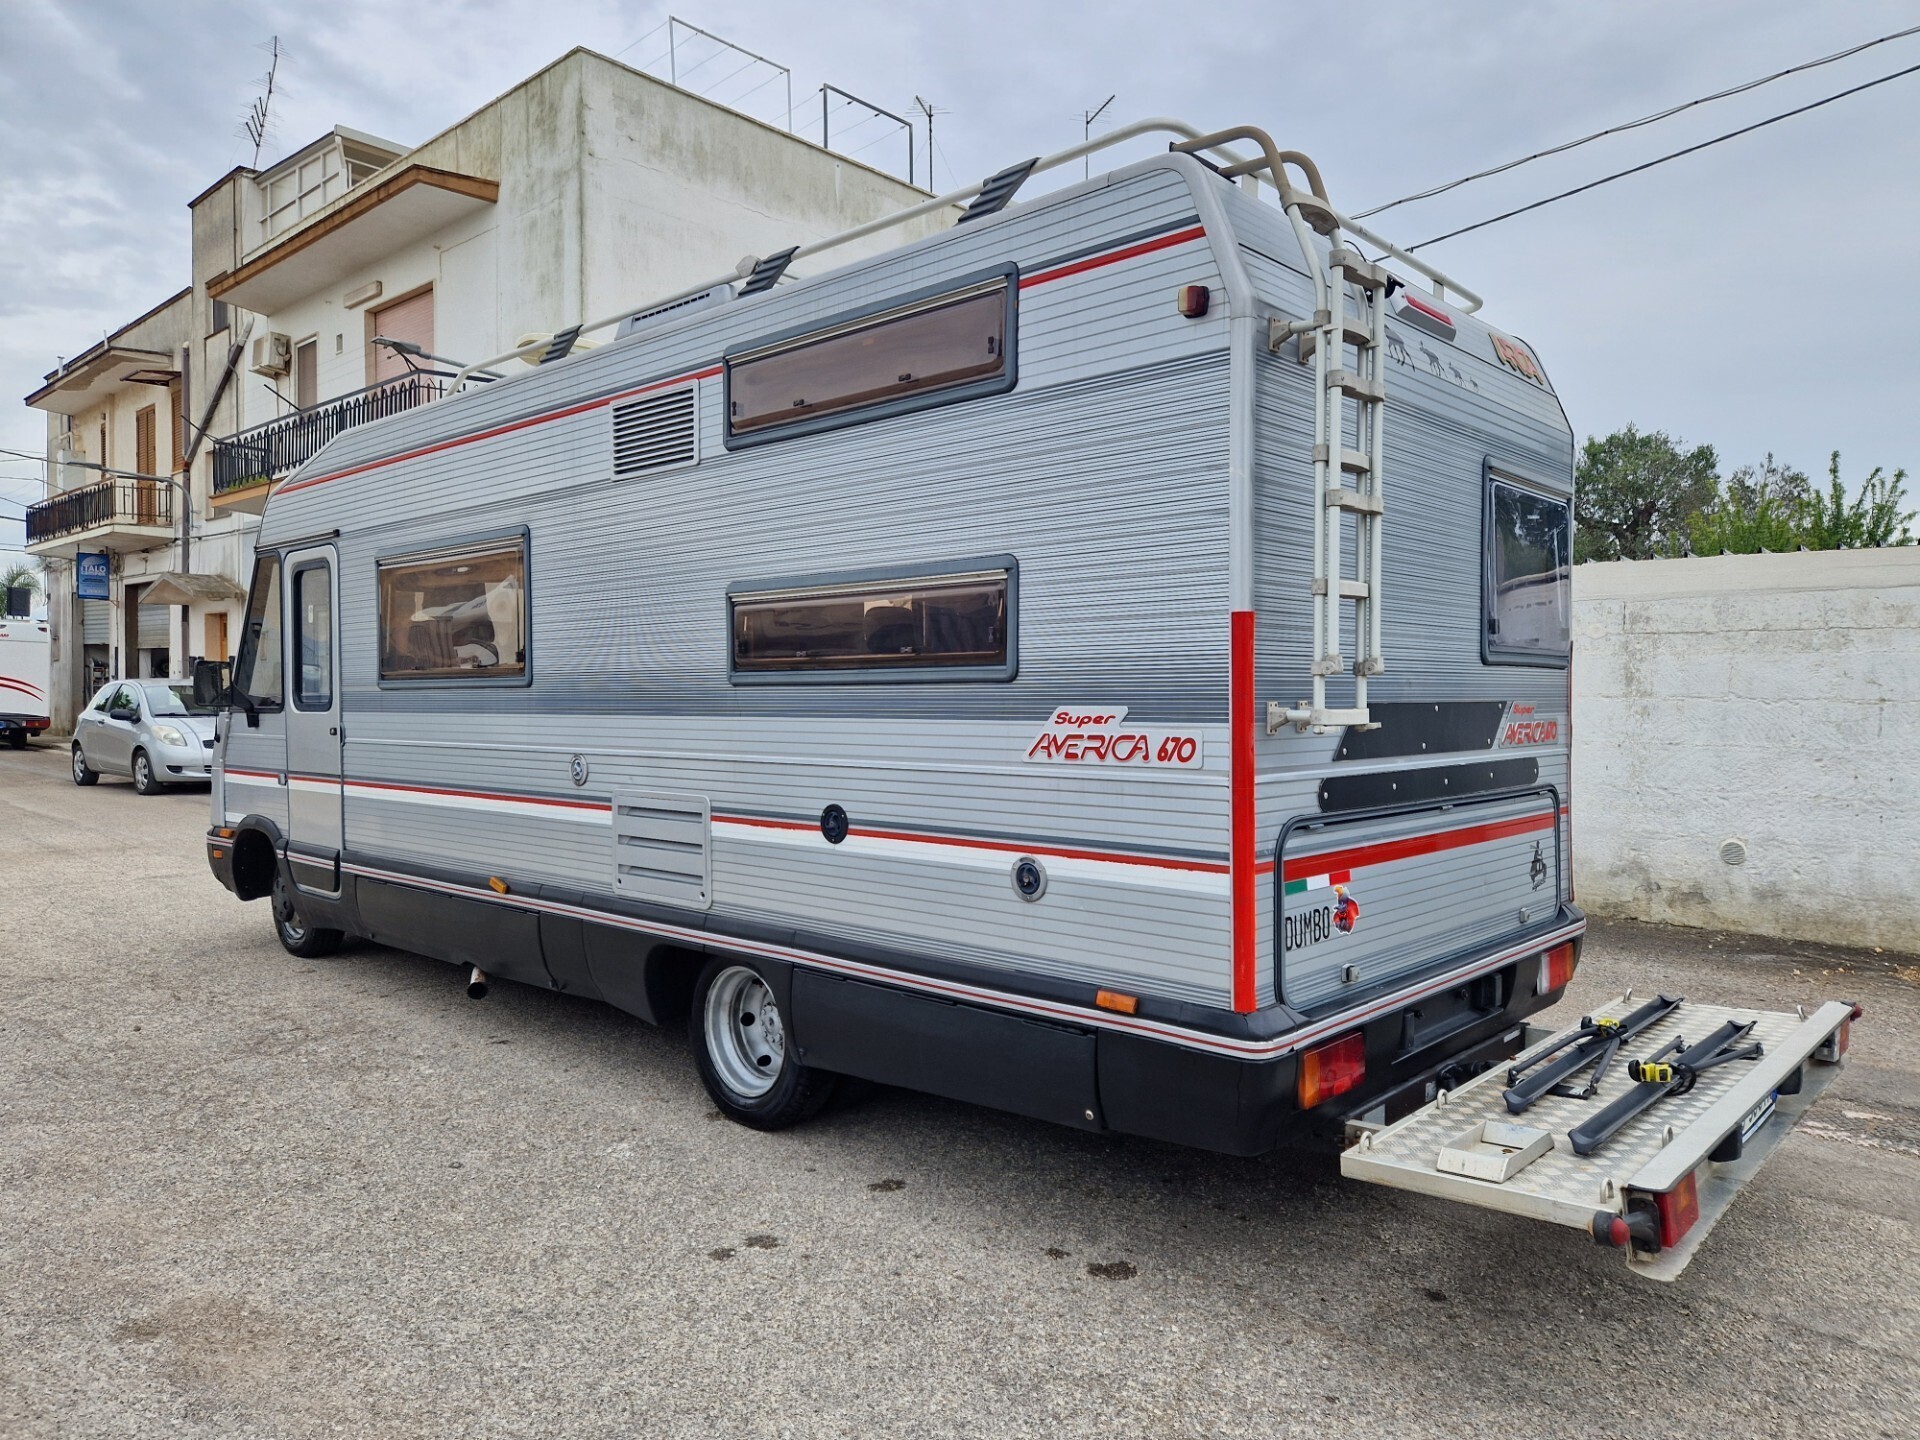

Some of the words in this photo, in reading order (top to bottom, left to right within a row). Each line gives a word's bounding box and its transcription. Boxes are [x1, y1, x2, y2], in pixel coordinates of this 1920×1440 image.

[1054, 711, 1116, 728] Super
[1512, 703, 1535, 717] Super
[1028, 733, 1150, 763] AMERICA
[1157, 736, 1197, 763] 670
[1285, 905, 1331, 952] DUMBO
